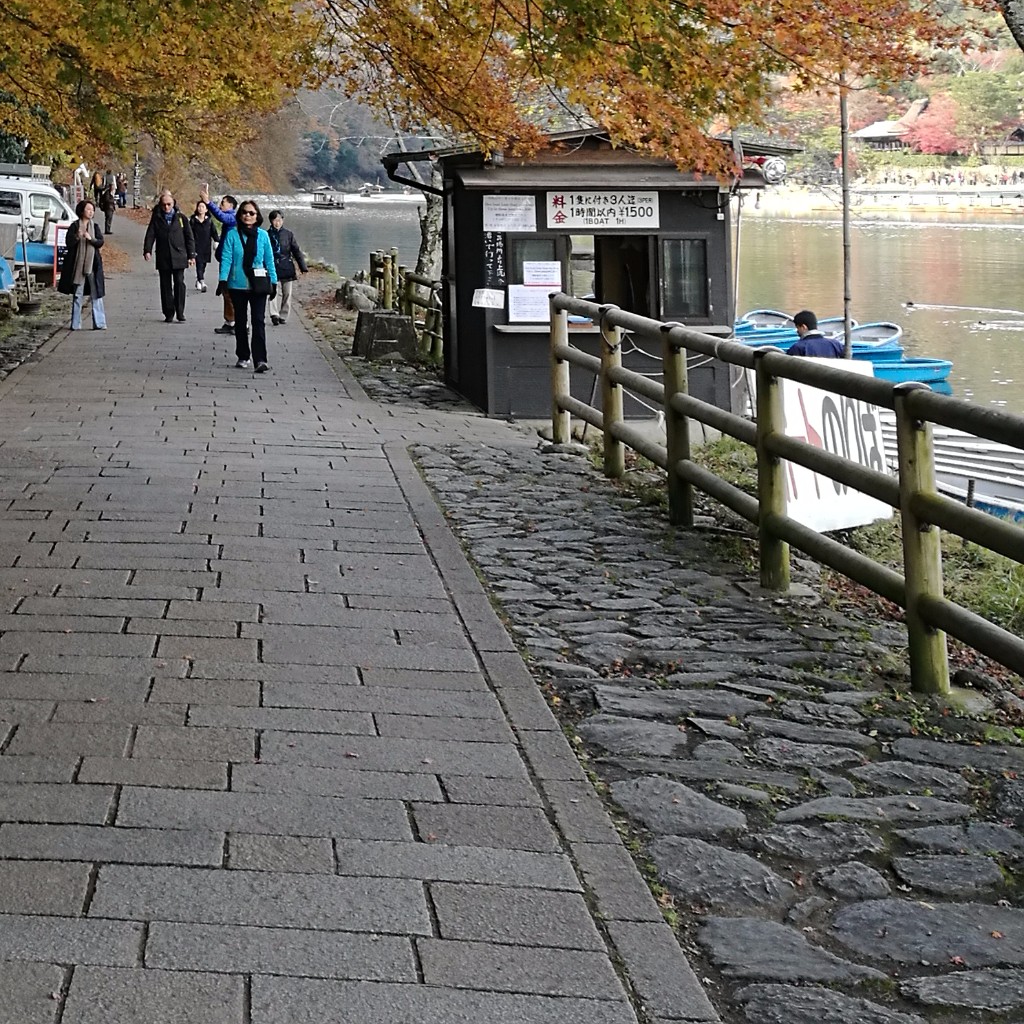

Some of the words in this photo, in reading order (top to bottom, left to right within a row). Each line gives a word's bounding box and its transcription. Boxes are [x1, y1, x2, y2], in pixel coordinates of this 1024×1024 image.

[552, 195, 568, 224] 料金
[570, 207, 617, 218] 1時間以内
[618, 206, 654, 218] ¥1500
